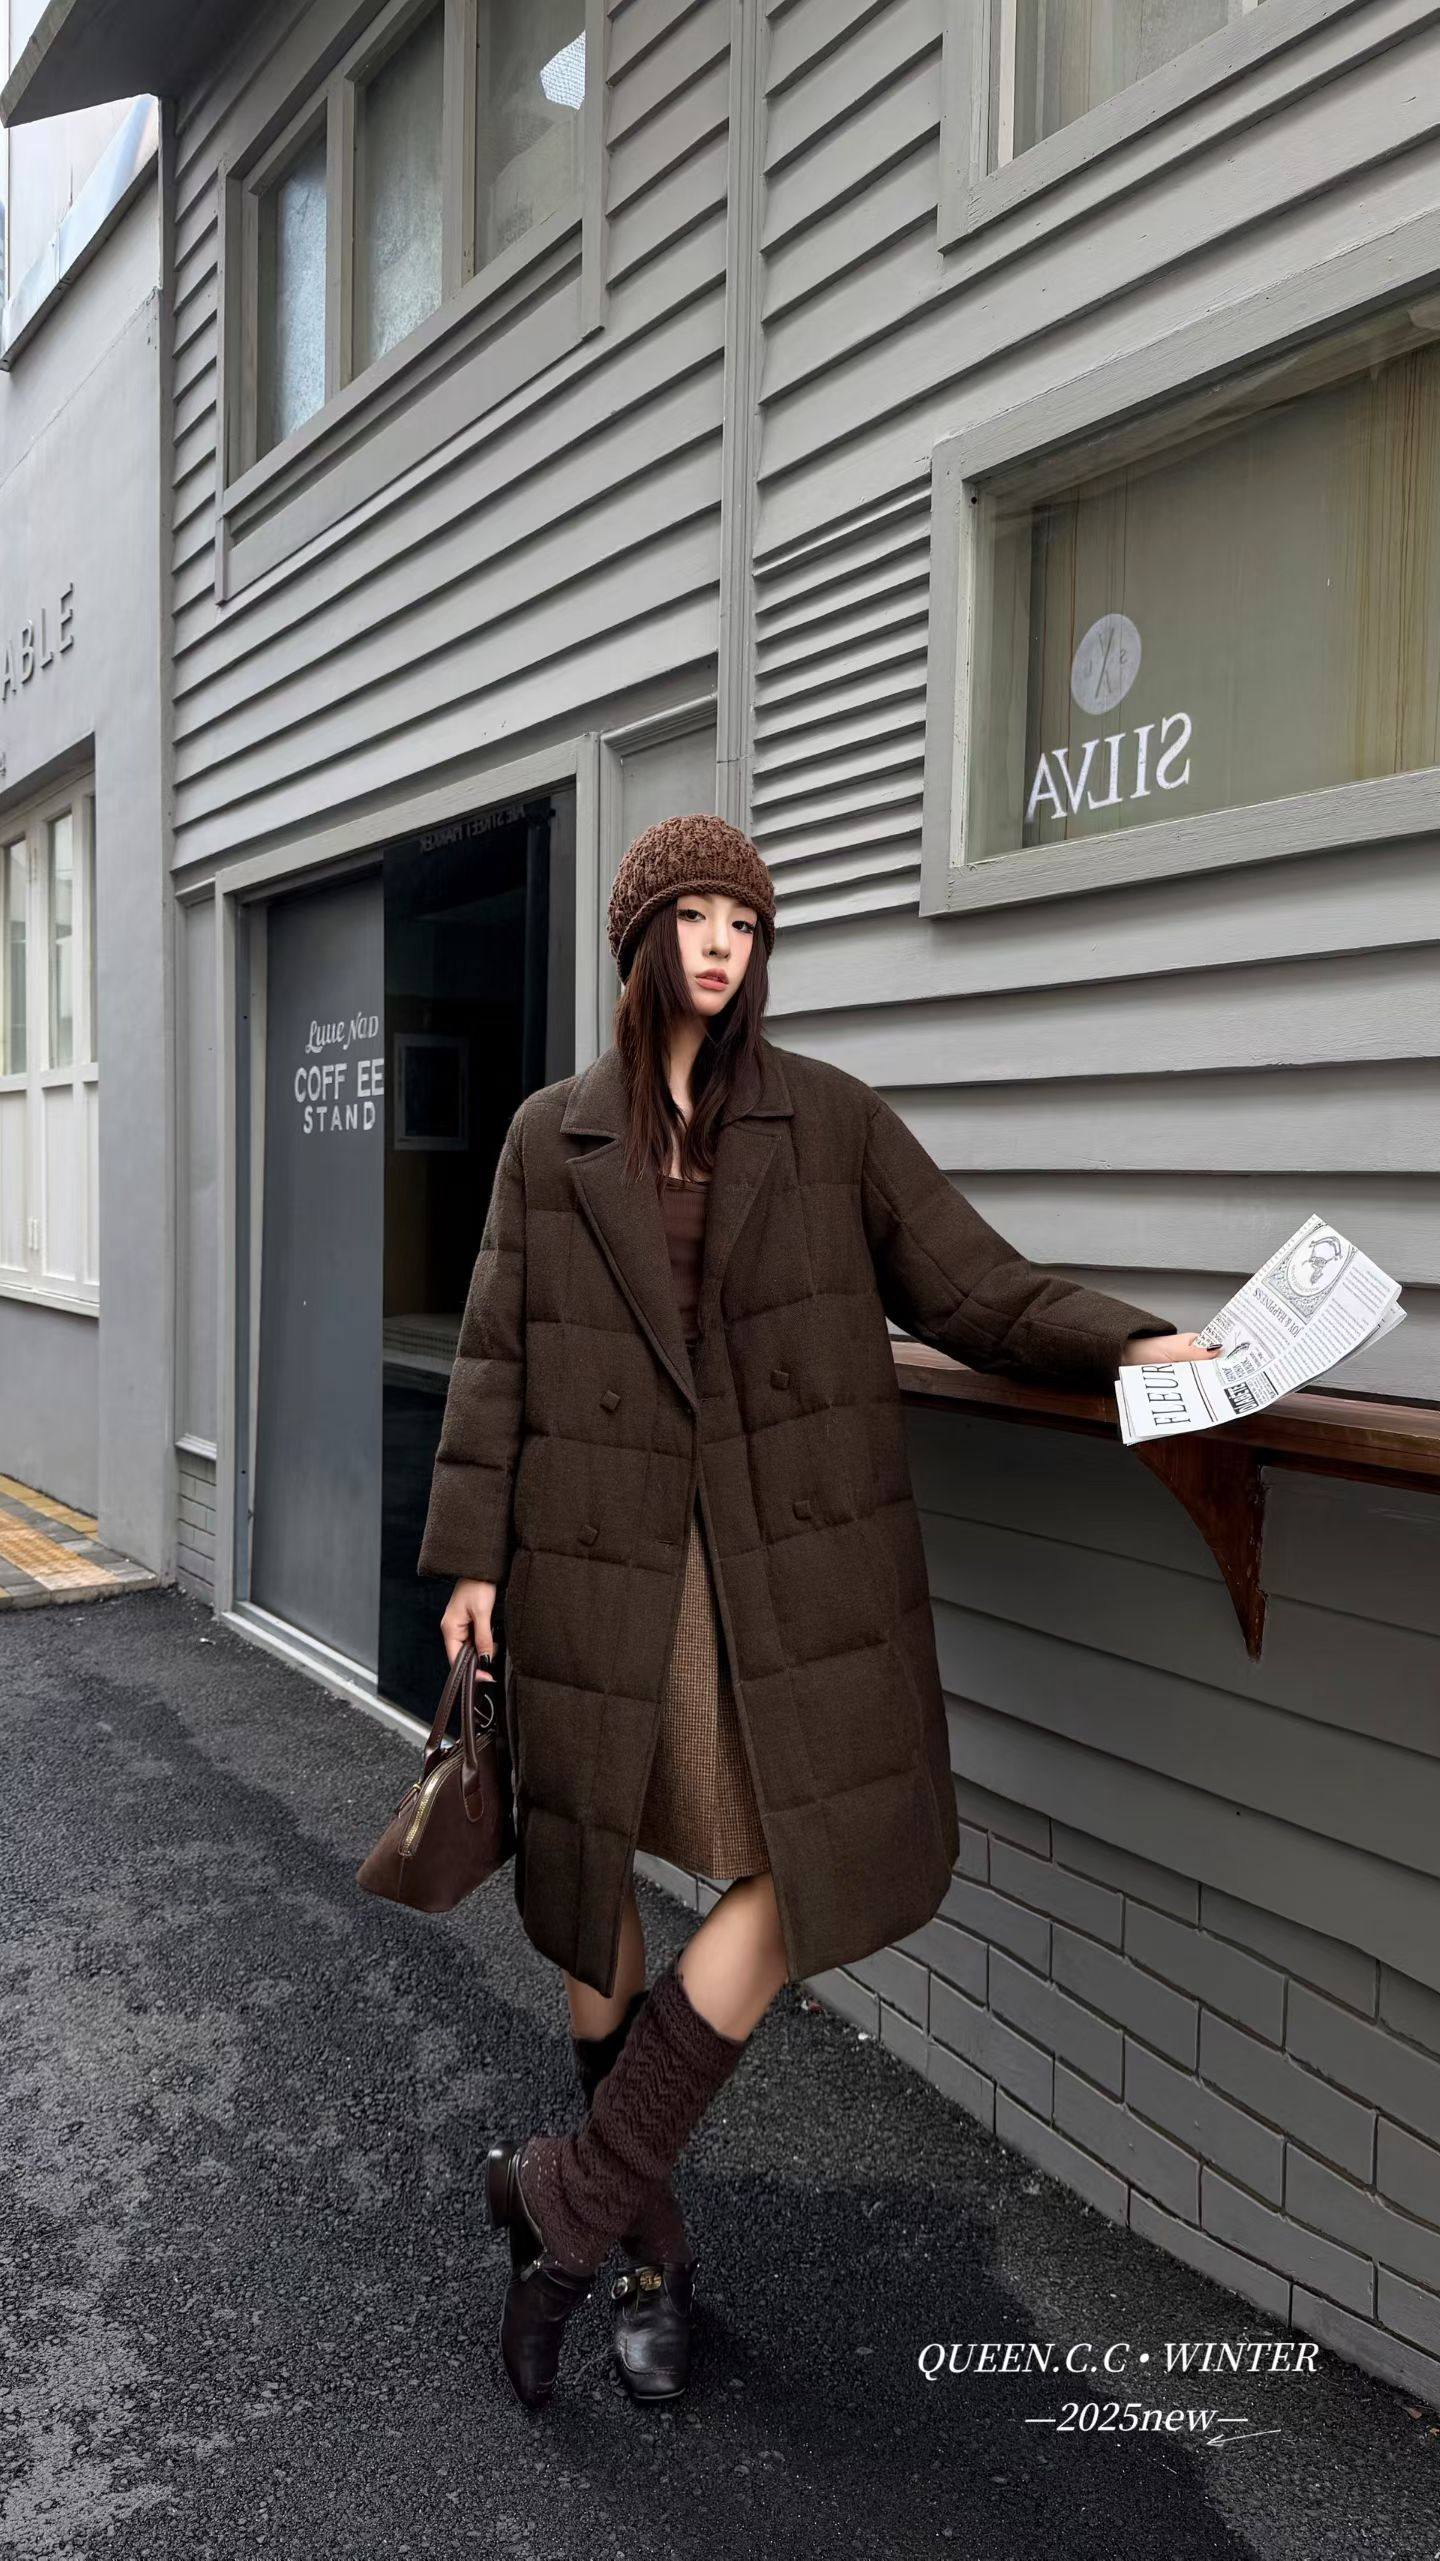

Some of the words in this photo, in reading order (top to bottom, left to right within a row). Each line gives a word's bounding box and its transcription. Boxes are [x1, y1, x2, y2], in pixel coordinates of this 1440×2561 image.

[1, 582, 73, 703] ABLE
[303, 1101, 376, 1134] STAND
[1141, 1364, 1191, 1426] FLEUR
